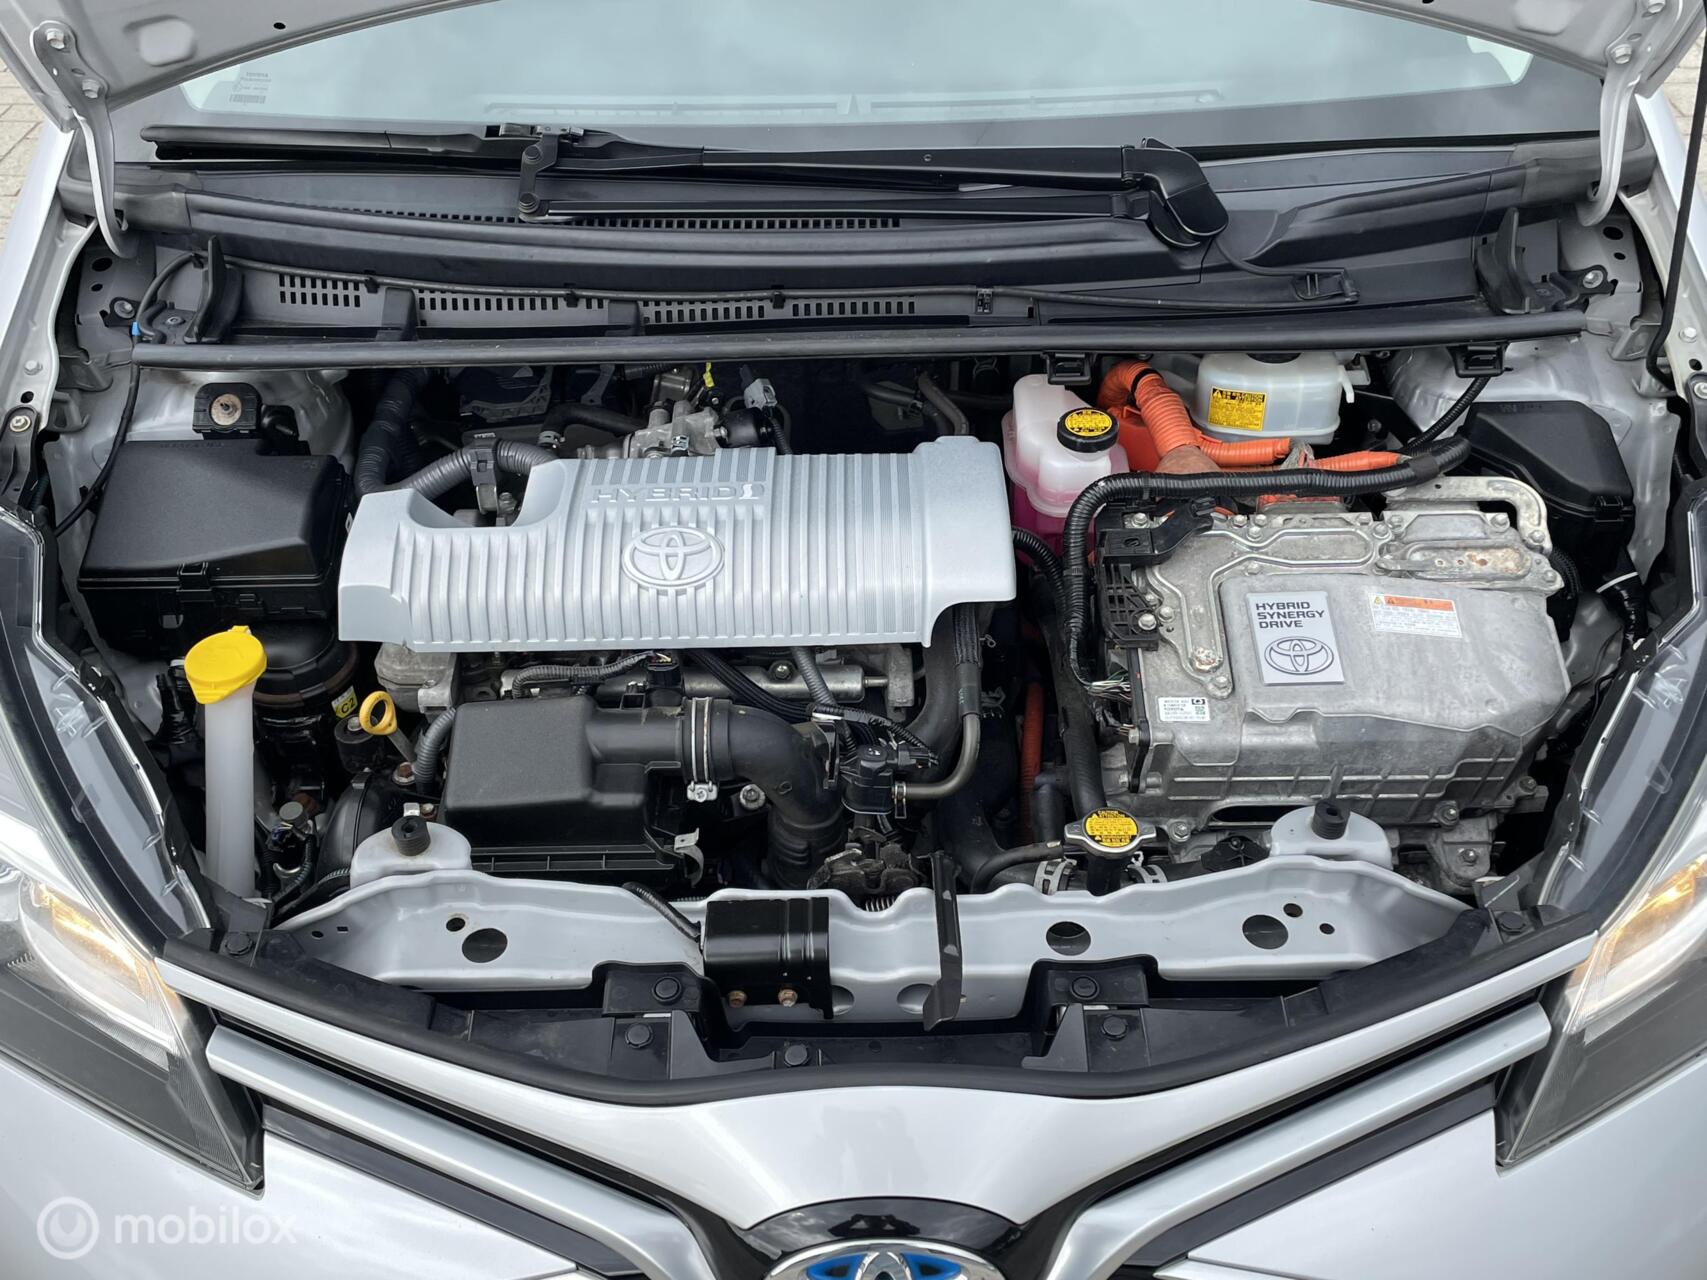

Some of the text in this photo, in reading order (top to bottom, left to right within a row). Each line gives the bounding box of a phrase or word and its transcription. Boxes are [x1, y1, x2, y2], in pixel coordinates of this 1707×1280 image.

[591, 487, 737, 503] HYBRID
[1255, 601, 1311, 611] HYBRID
[1257, 610, 1325, 620] SYNERGY
[1259, 620, 1303, 629] DRIVE
